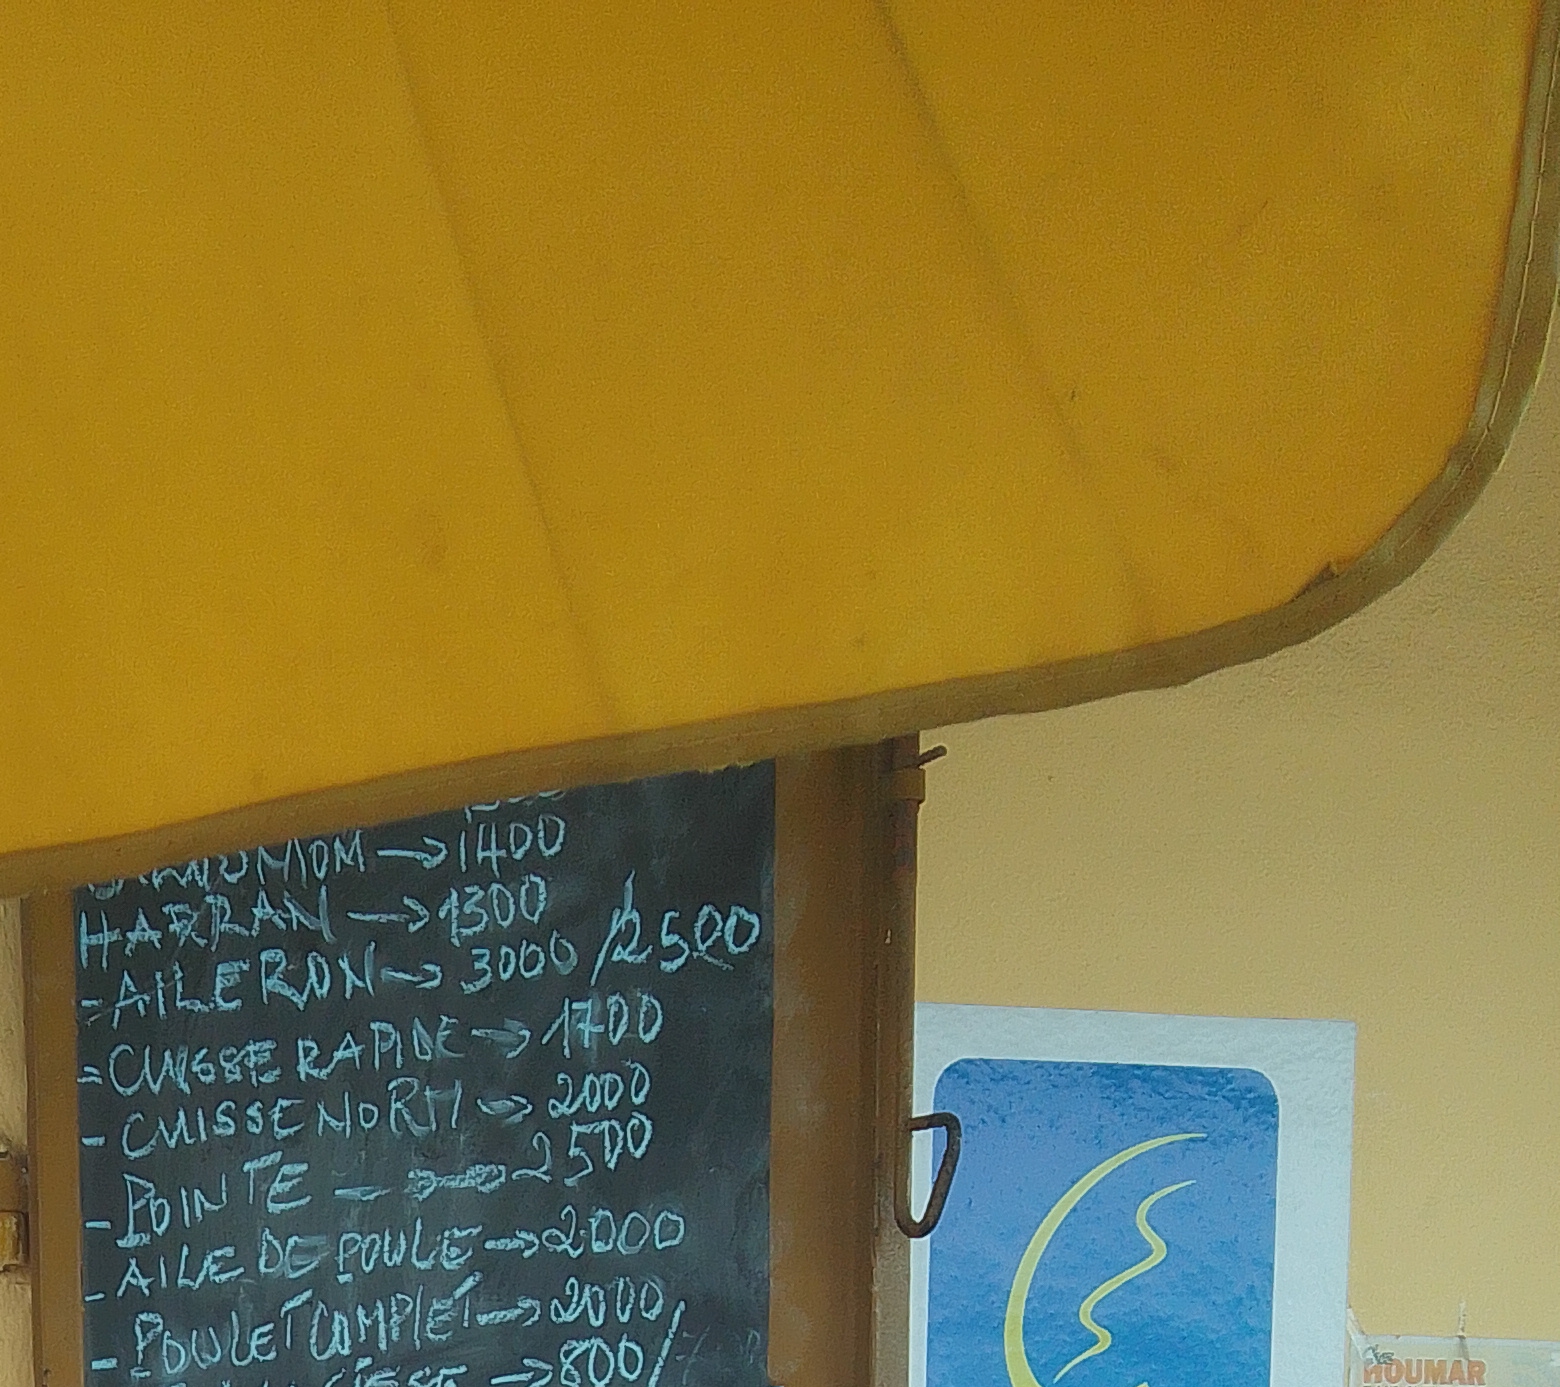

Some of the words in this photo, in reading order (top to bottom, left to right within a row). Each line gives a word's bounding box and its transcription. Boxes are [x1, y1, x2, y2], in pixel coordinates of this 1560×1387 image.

[459, 813, 566, 878] 1400
[459, 929, 578, 995] 3000
[541, 992, 663, 1059] 1700
[121, 1098, 305, 1160] CUISSE
[548, 1060, 651, 1119] 2000
[116, 1151, 312, 1248] POINTE
[511, 1111, 653, 1188] 2500
[116, 1245, 244, 1297] AILE
[258, 1227, 323, 1278] DE
[338, 1217, 483, 1283] POULE
